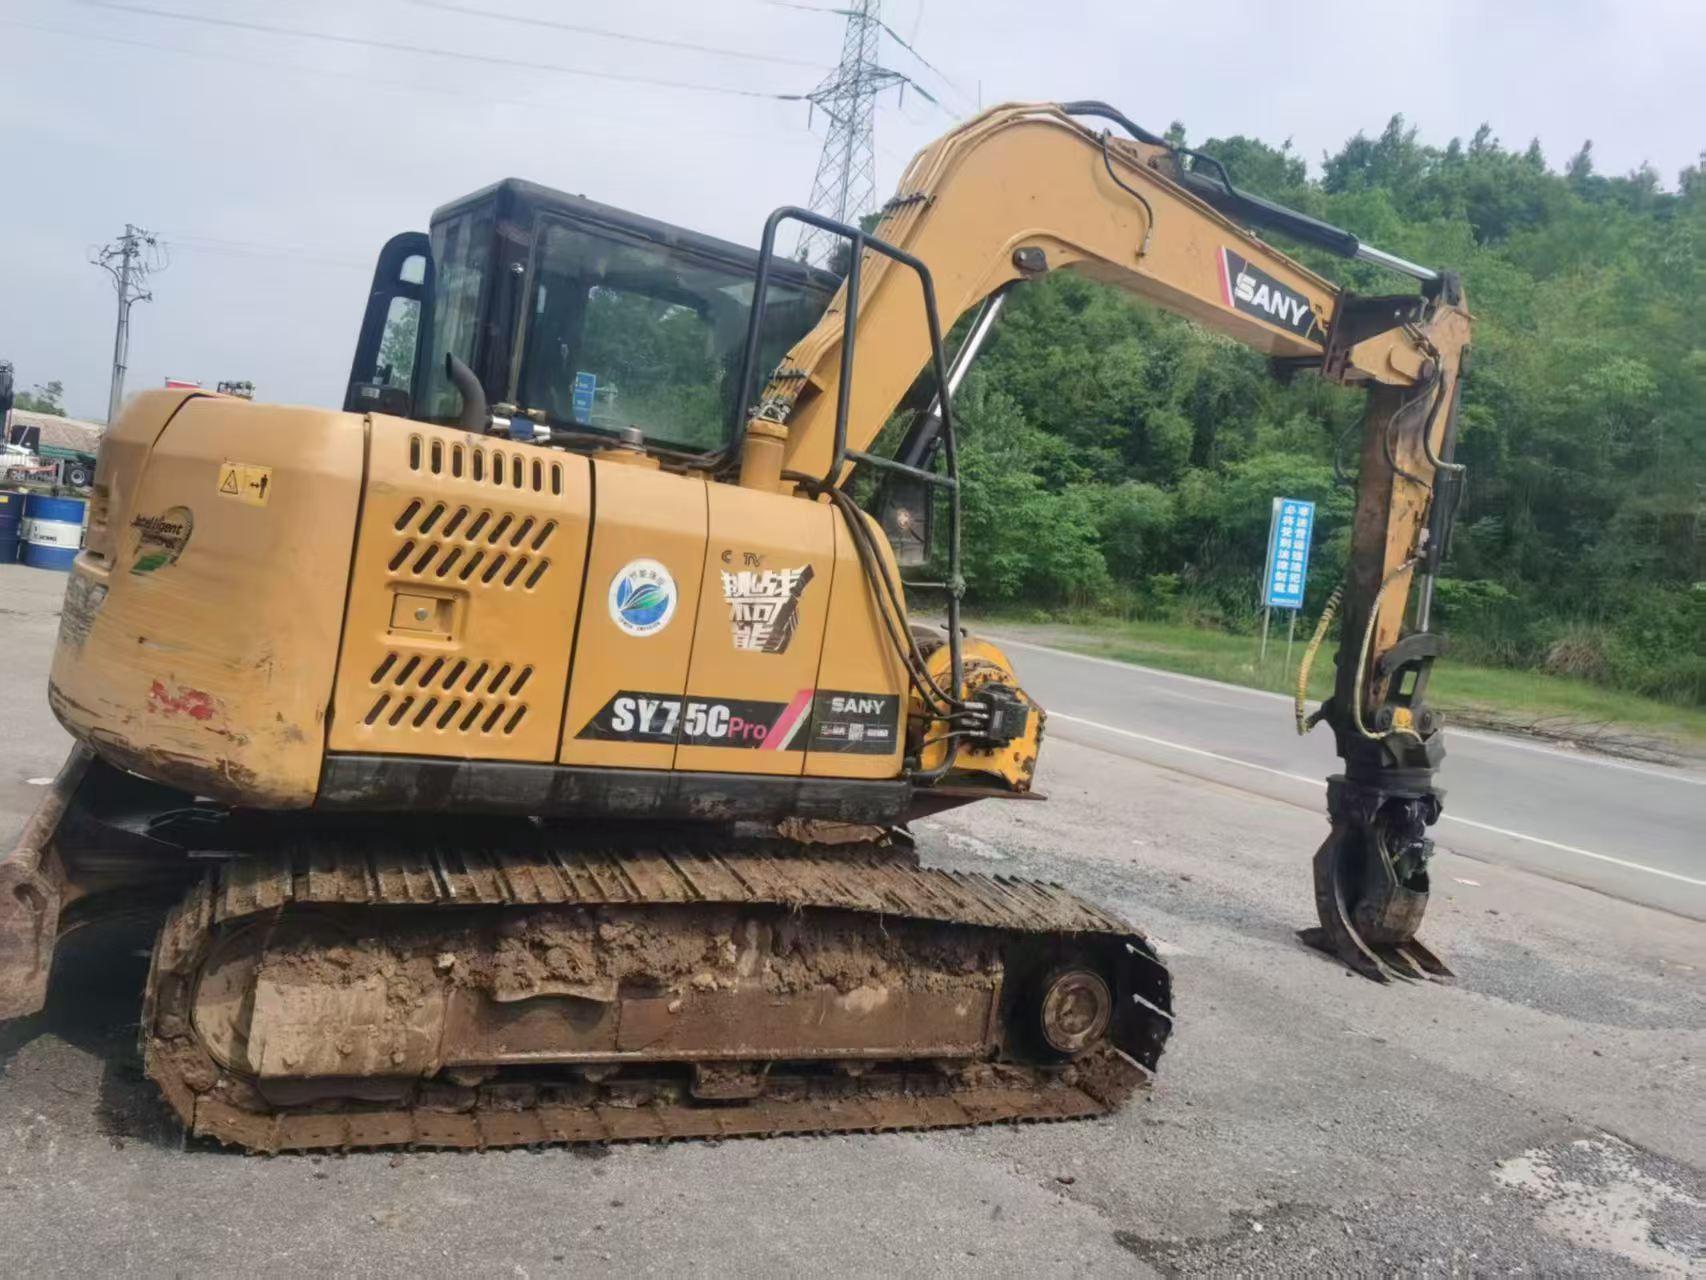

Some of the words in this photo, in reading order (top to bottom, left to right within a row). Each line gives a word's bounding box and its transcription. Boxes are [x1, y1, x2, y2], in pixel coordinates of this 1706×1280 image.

[1234, 272, 1308, 326] SANY
[721, 565, 806, 598] 挑战
[725, 596, 790, 625] 不可
[732, 621, 774, 651] 能
[831, 697, 885, 714] SANY
